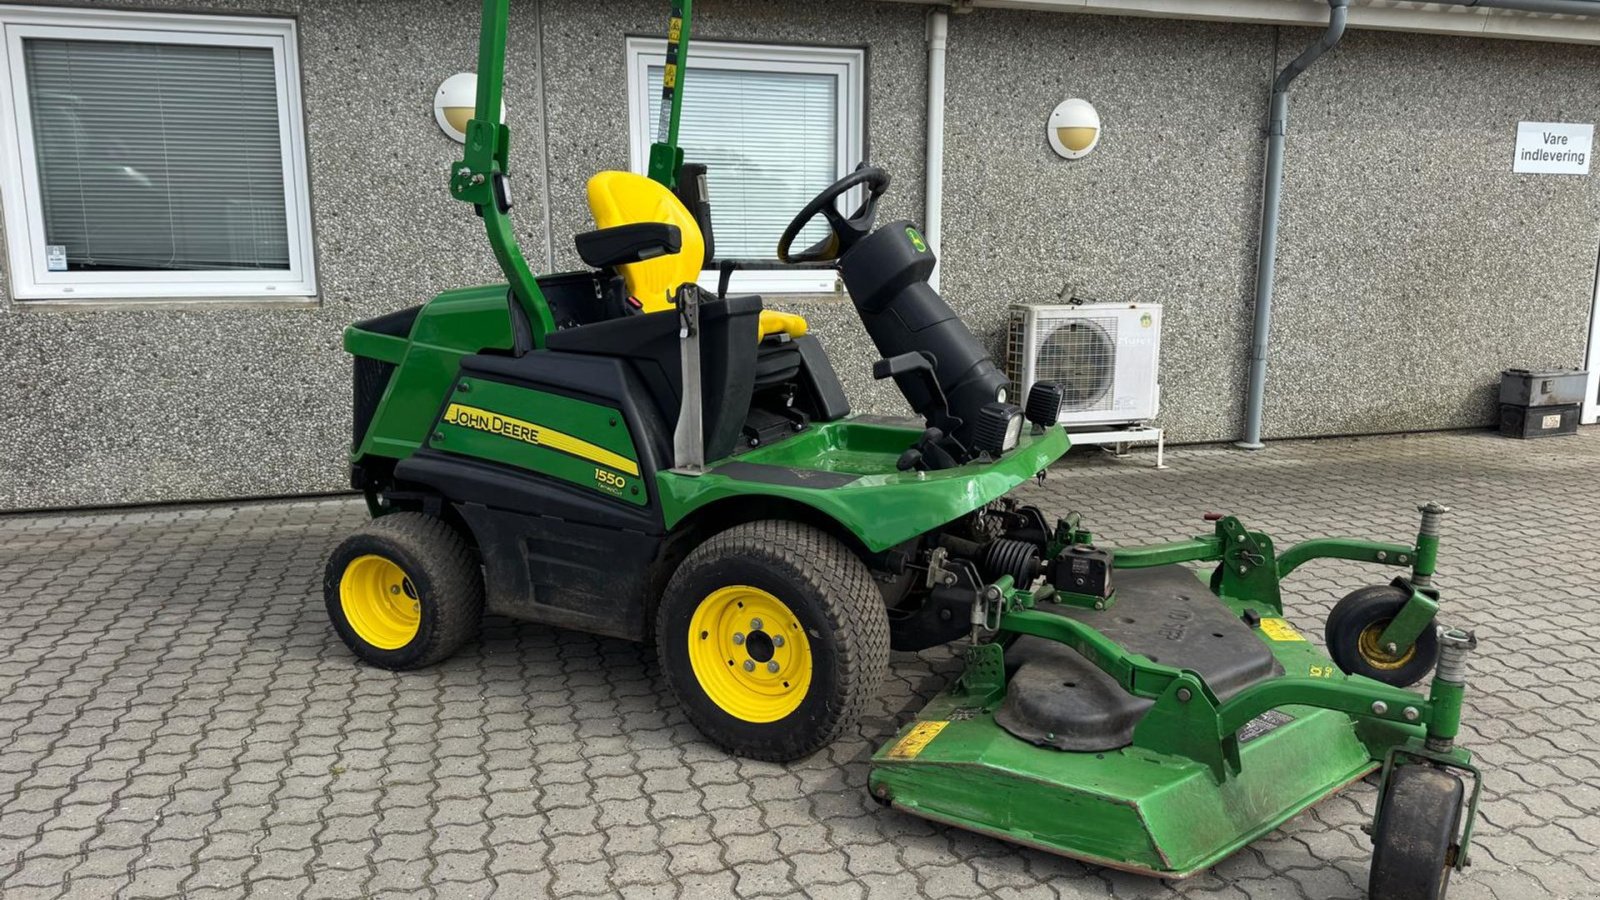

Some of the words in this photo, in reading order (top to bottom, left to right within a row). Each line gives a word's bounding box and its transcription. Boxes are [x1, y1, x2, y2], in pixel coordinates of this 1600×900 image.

[1543, 131, 1568, 145] Vare
[1521, 147, 1585, 165] indlevering
[451, 408, 489, 429] JOHN
[492, 416, 539, 442] DEERE
[594, 468, 626, 488] 1550
